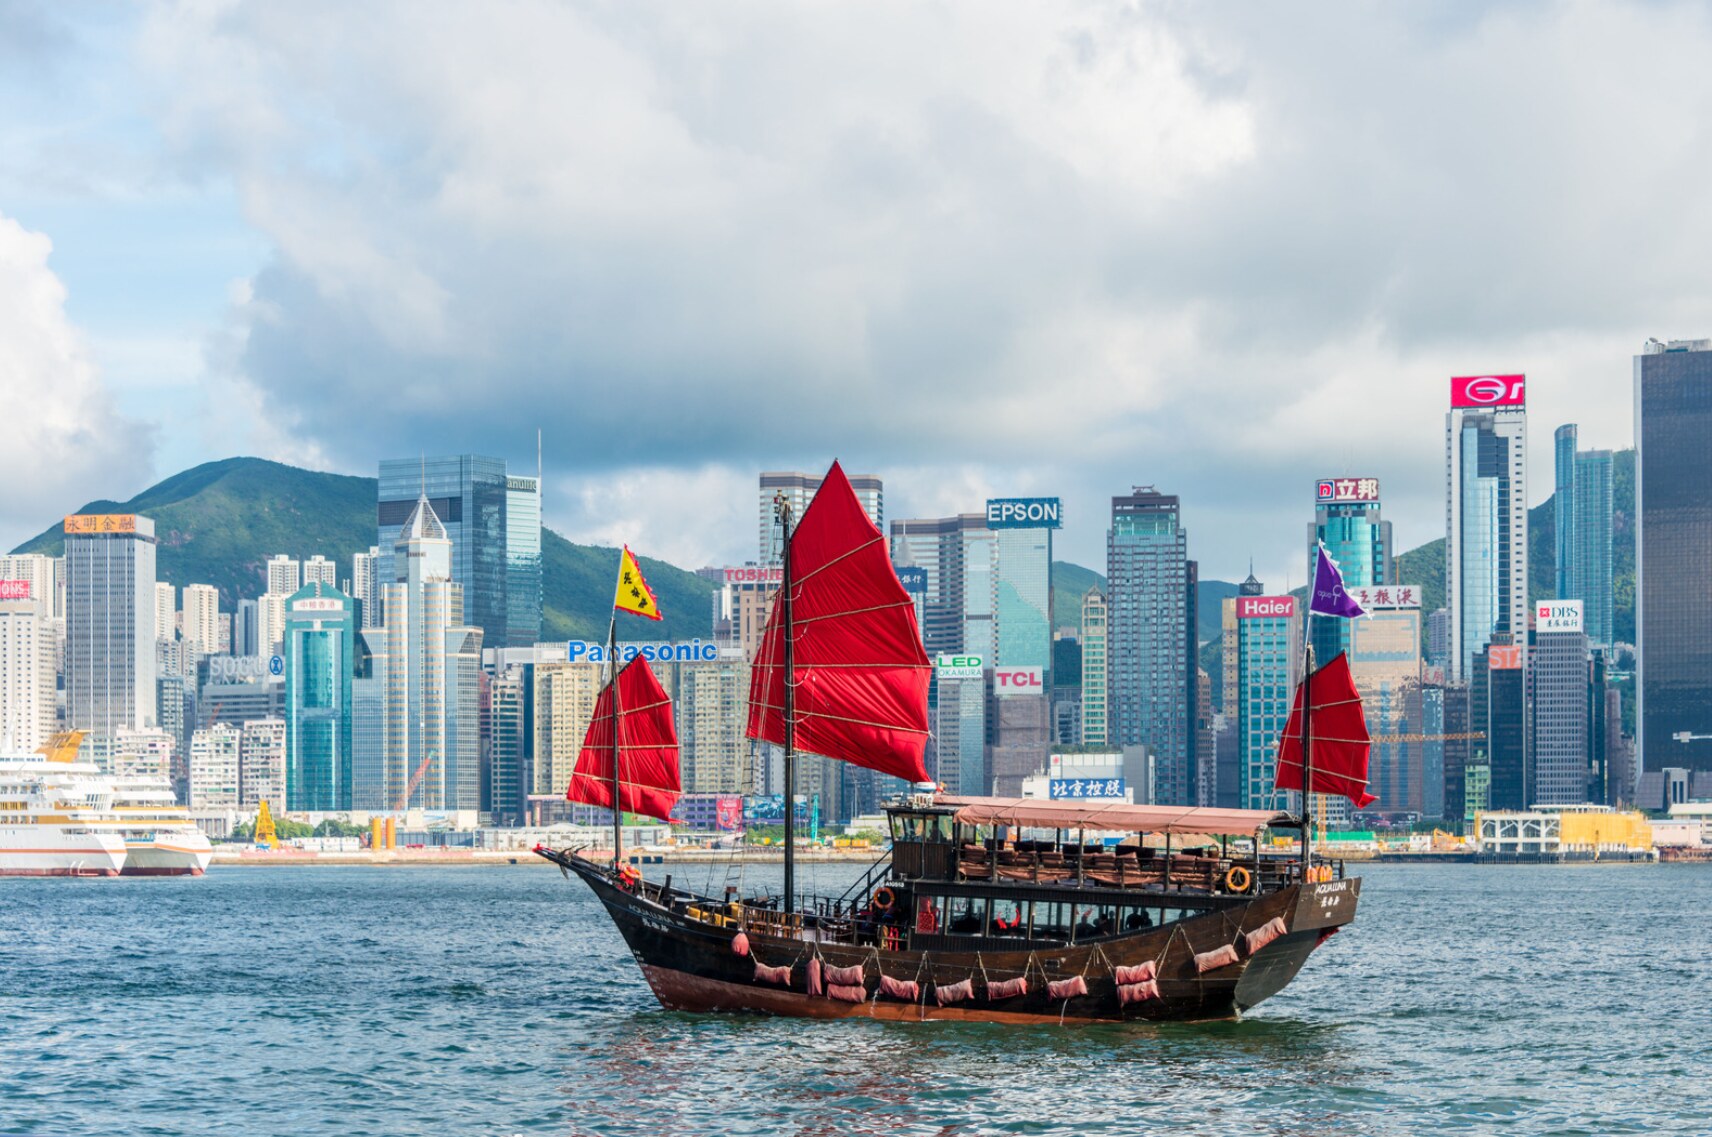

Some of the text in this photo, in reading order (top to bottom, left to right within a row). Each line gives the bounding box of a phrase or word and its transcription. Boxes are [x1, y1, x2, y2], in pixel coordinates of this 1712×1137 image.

[1336, 479, 1377, 500] 立邦
[988, 503, 1057, 521] EPSON
[66, 515, 135, 531] 永明金融
[724, 569, 785, 582] TOSHIB
[1245, 600, 1291, 614] Haier
[1552, 607, 1578, 617] DBS
[568, 639, 717, 662] Panasonic
[210, 656, 265, 676] SOGO
[938, 657, 982, 667] LED
[996, 672, 1041, 687] TCL
[1052, 780, 1123, 797] 北京控股
